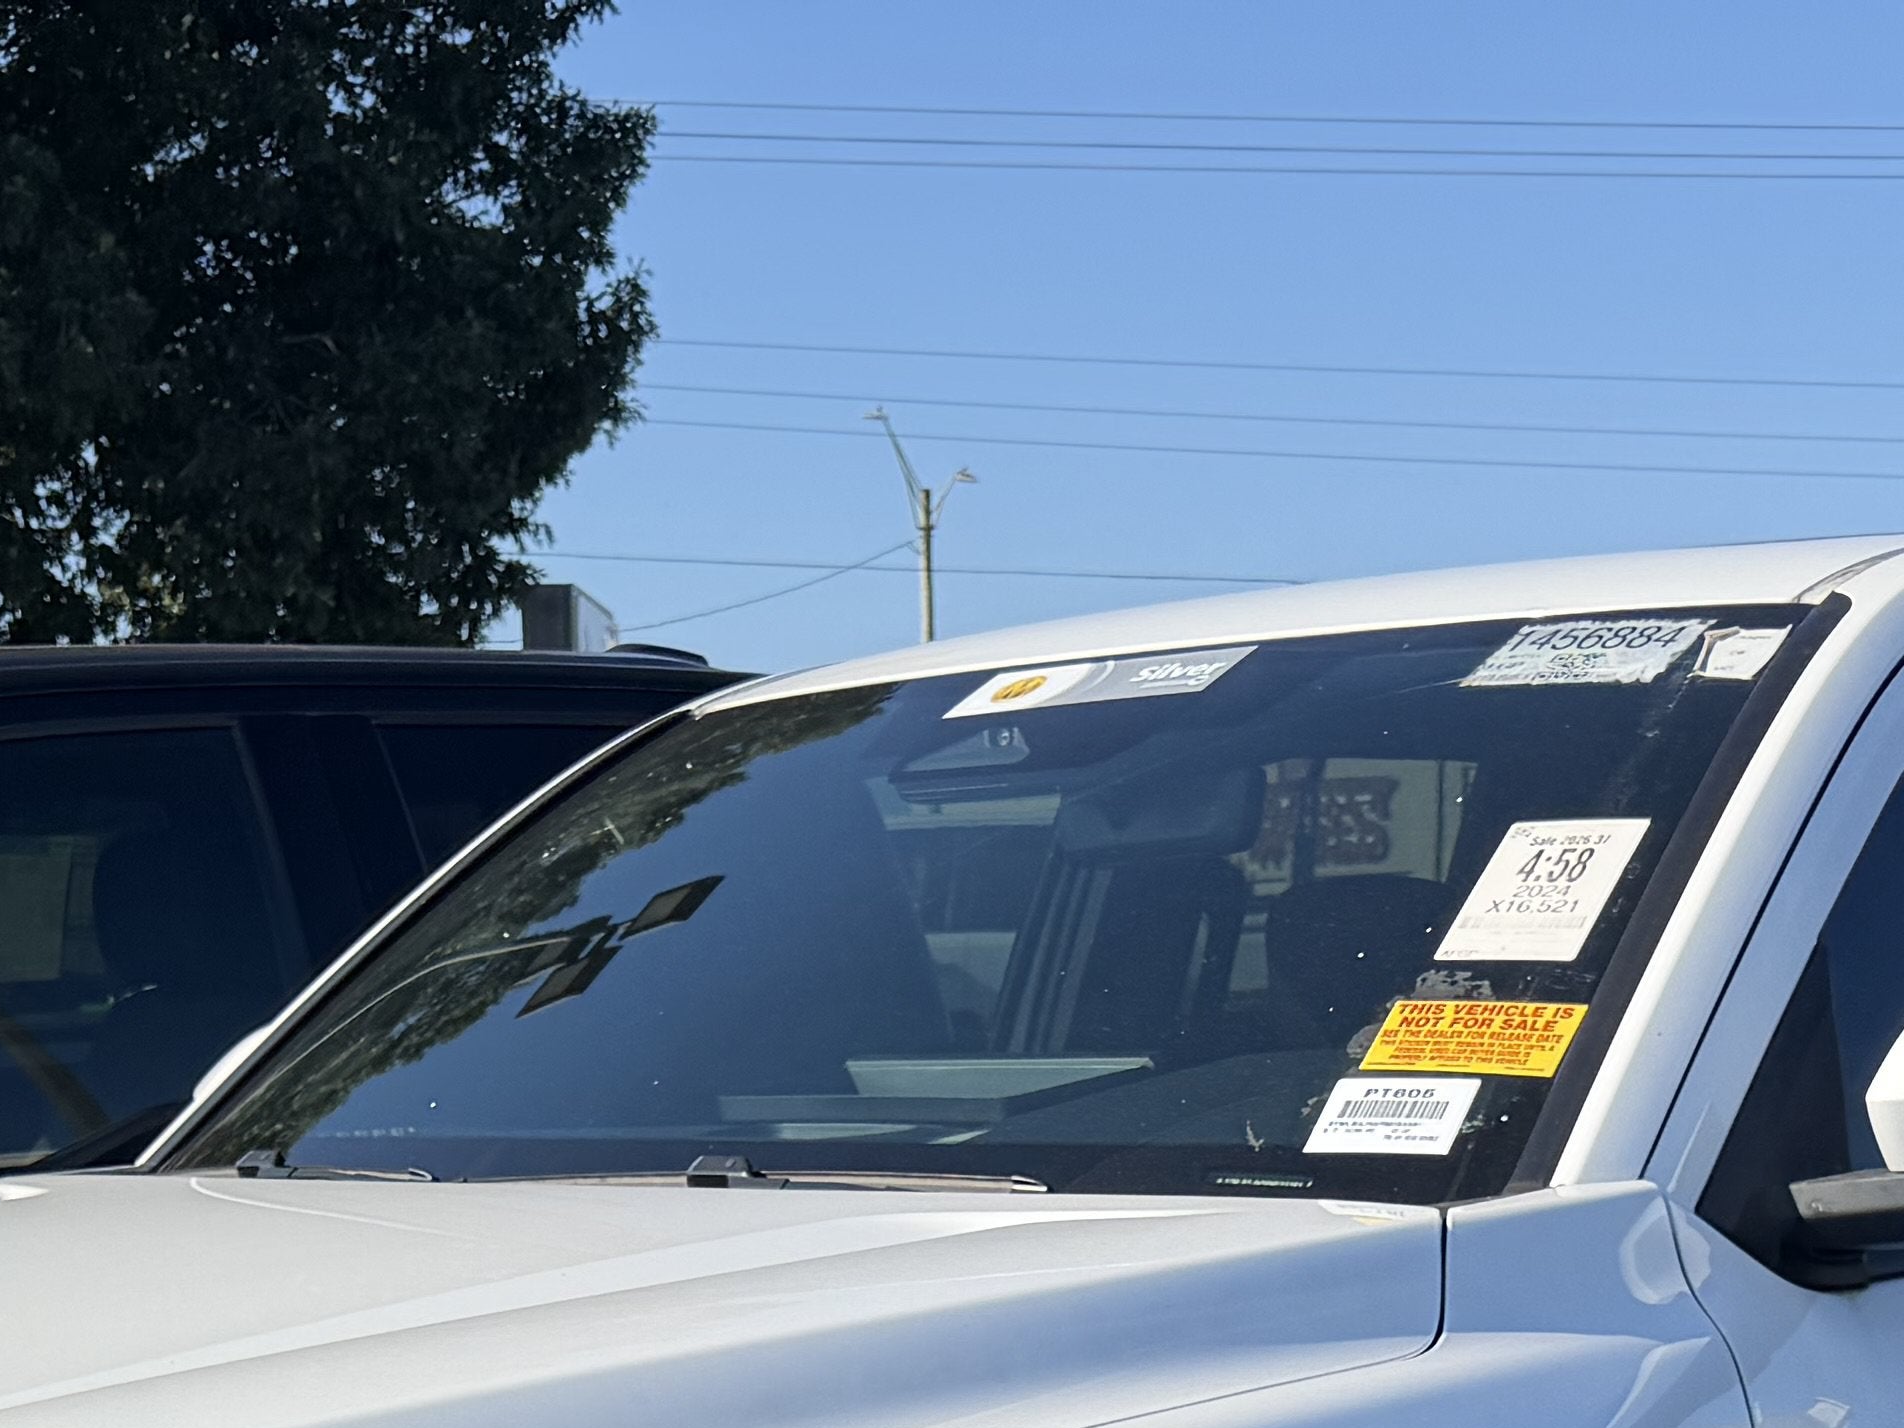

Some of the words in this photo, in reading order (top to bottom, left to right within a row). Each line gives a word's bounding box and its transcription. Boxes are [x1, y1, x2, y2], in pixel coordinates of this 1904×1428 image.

[1508, 626, 1688, 652] 1456884
[1516, 847, 1595, 883] 4:58
[1512, 885, 1572, 898] 2024
[1399, 1003, 1447, 1015] THIS
[1453, 1004, 1548, 1017] VEHICLE
[1552, 1007, 1575, 1019] IS
[1398, 1016, 1446, 1028] NOT
[1448, 1017, 1495, 1029] FOR
[1498, 1018, 1559, 1032] SALE
[1381, 1029, 1400, 1038] SEE
[1402, 1029, 1424, 1038] THE
[1424, 1030, 1464, 1039] DEALER
[1464, 1031, 1486, 1040] FOR
[1487, 1031, 1536, 1042] RELEASE
[1535, 1033, 1565, 1043] DATE
